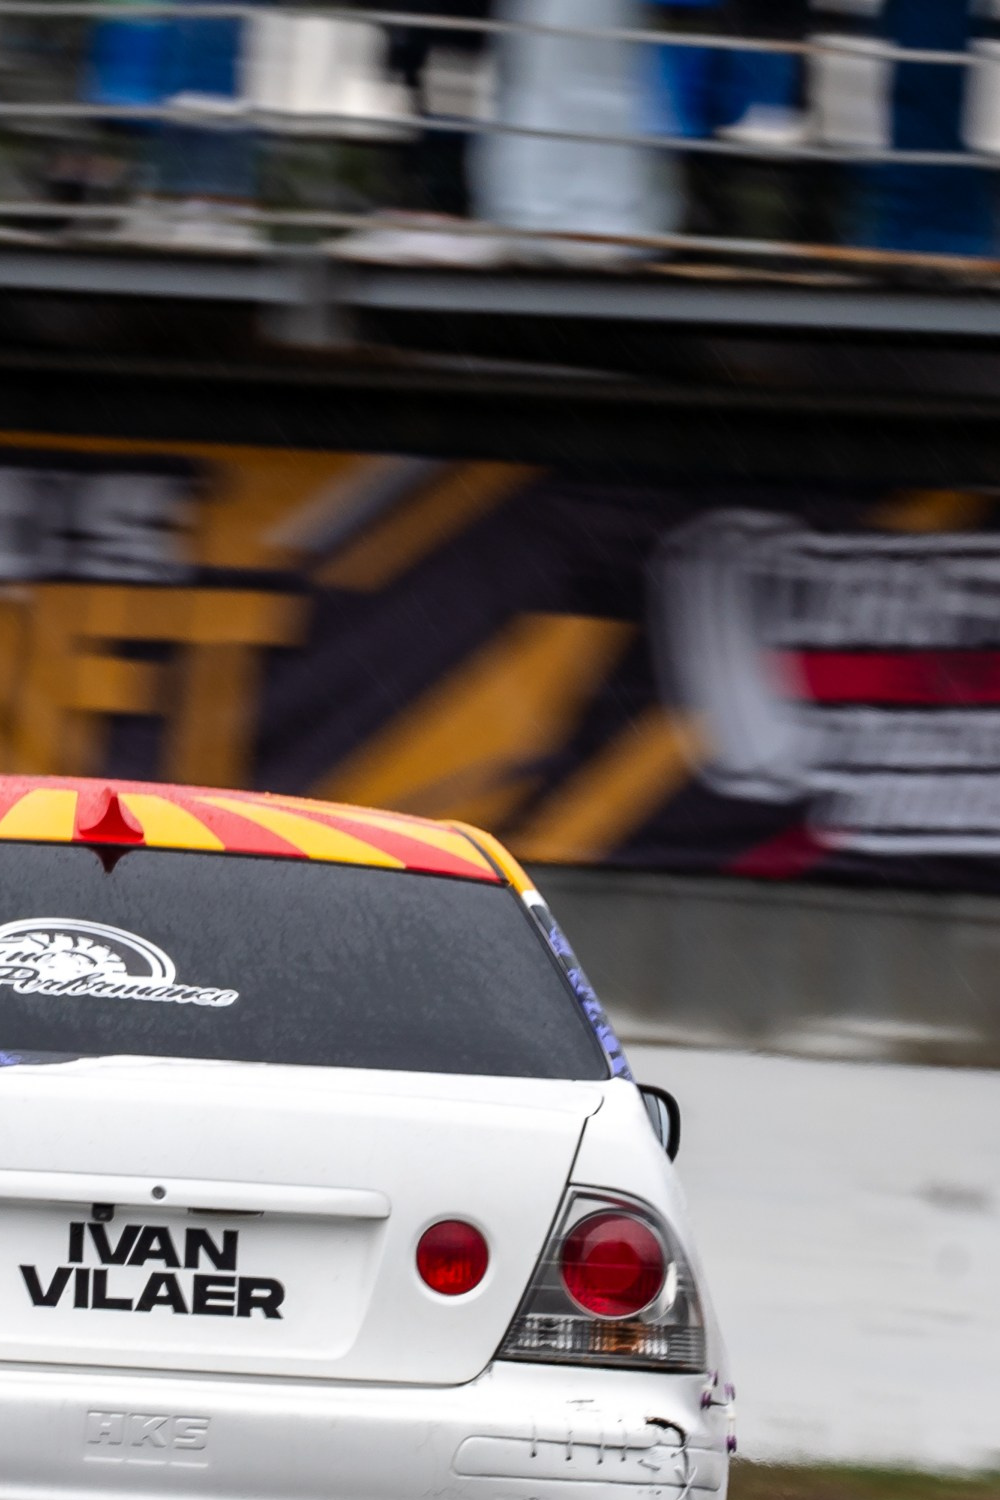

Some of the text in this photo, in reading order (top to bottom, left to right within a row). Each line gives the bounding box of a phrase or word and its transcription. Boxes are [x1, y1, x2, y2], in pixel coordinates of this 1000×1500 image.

[68, 1222, 239, 1271] IVAN
[19, 1264, 285, 1319] VILAER
[86, 1410, 211, 1451] HKS
